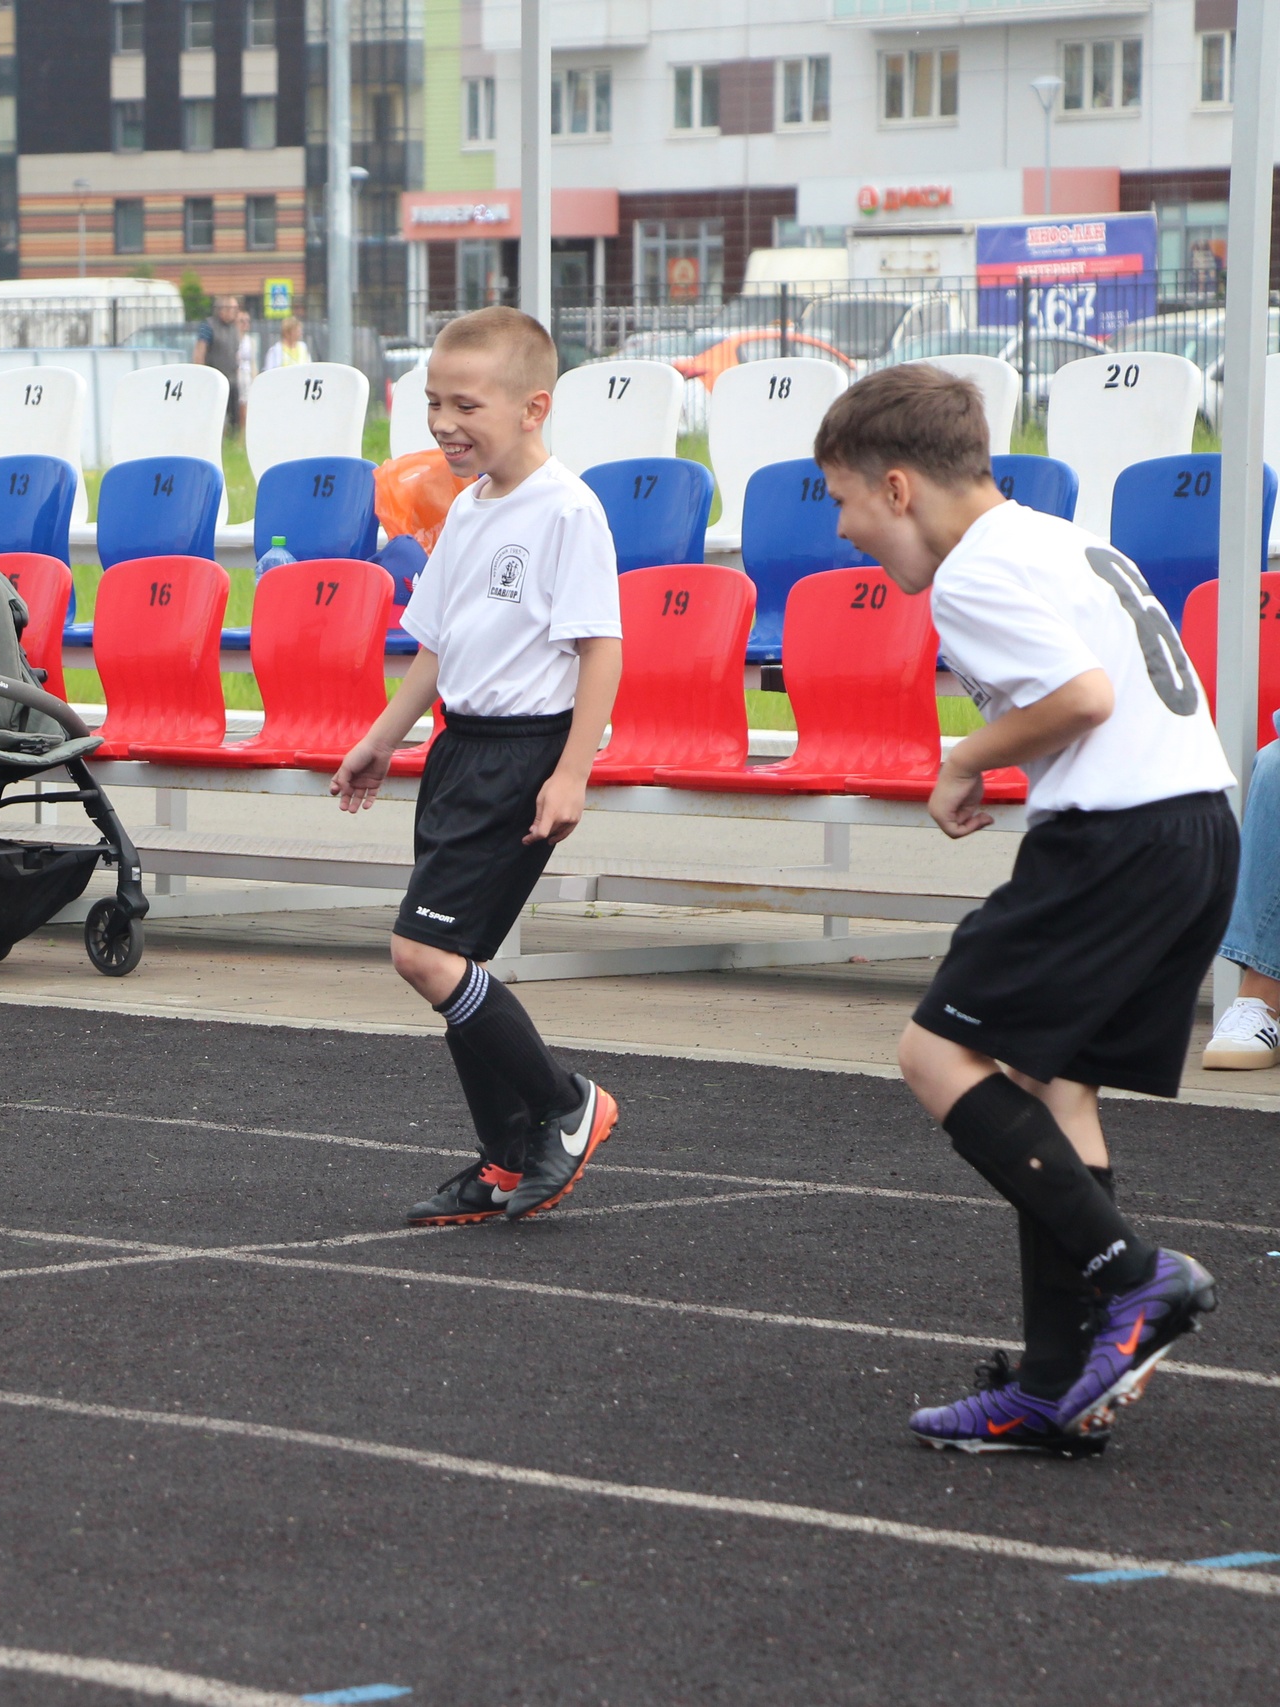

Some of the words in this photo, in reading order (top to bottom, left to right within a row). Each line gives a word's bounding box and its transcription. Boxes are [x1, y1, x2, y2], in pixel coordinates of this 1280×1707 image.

[608, 376, 631, 399] 17
[768, 376, 791, 400] 18
[1104, 364, 1140, 388] 20
[24, 384, 43, 406] 13
[164, 379, 183, 401] 14
[304, 379, 323, 400] 15
[9, 472, 30, 495] 13
[153, 473, 174, 496] 14
[313, 474, 335, 497] 15
[633, 475, 658, 499] 17
[801, 477, 826, 501] 18
[1173, 471, 1211, 497] 20
[150, 582, 171, 606] 16
[316, 581, 339, 606] 17
[662, 590, 690, 616] 19
[851, 583, 887, 609] 20
[1084, 546, 1199, 717] 6
[415, 905, 431, 917] 2K
[428, 911, 456, 923] SPORT
